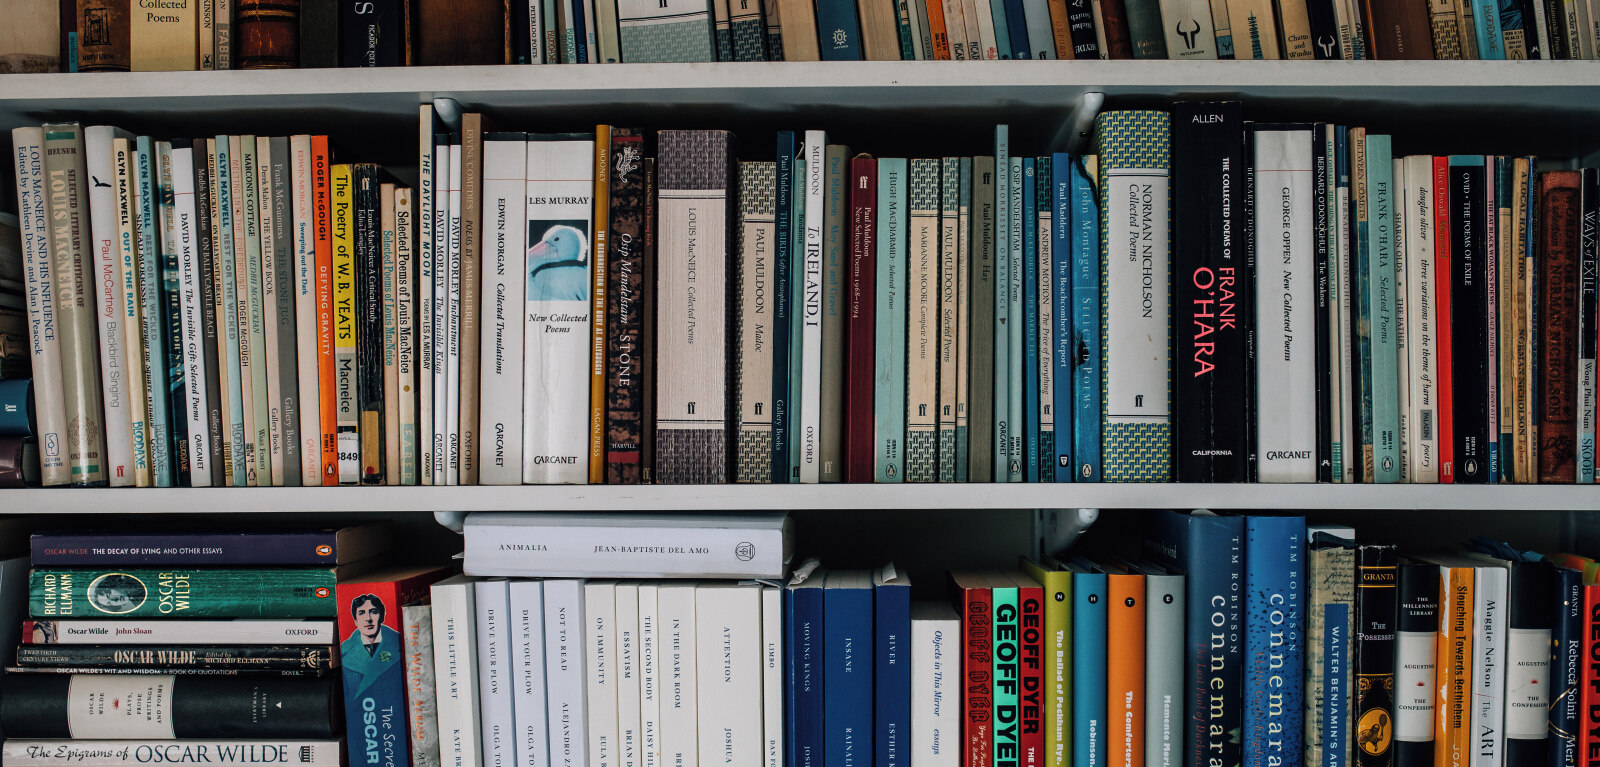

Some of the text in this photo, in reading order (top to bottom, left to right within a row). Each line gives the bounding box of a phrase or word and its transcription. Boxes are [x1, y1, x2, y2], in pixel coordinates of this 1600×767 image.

[147, 12, 180, 22] Poems
[1484, 5, 1498, 53] BLOODAXE
[218, 30, 229, 70] FABER
[1289, 49, 1312, 58] Windus
[1192, 114, 1223, 123] ALLEN
[18, 145, 29, 174] Edited
[29, 145, 42, 176] LOUIS
[317, 154, 325, 187] ROGER
[811, 145, 820, 195] MULDOON
[18, 176, 30, 188] by
[1059, 182, 1067, 199] Paul
[1378, 181, 1388, 220] FRANK
[21, 190, 33, 230] Kathleen
[1059, 201, 1067, 238] Maddern
[1128, 183, 1140, 261] Collected Poems
[1222, 156, 1231, 259] THE COLLECTED POEMS OF
[1282, 186, 1291, 264] GEORGE OPPEN
[24, 232, 35, 263] Devine
[36, 235, 48, 259] AND
[117, 150, 135, 316] GLYN MAXWELL OUT OF THE RAIN
[808, 226, 820, 238] To
[1142, 184, 1153, 318] NORMAN NICHOLSON
[27, 266, 37, 283] and
[39, 261, 49, 278] HIS
[334, 174, 352, 339] The Poetry of W. B. YEATS
[1059, 259, 1067, 275] The
[28, 286, 39, 306] Alan
[320, 265, 329, 308] DEFYING
[398, 210, 411, 373] Selected Poems of Louis MacNeice
[1219, 266, 1236, 330] FRANK
[40, 281, 54, 341] INFLUENCE
[100, 239, 120, 407] Paul McCartney Blackbird Singing
[550, 314, 587, 322] Collected
[617, 233, 633, 386] Osip Mandelstam STONE
[1193, 266, 1216, 376] O'HARA
[31, 319, 42, 354] Peacock
[321, 312, 330, 355] GRAVITY
[545, 325, 570, 333] Poems
[1057, 338, 1068, 367] Report
[340, 358, 353, 412] Macneice
[132, 420, 146, 469] BLOODAXE
[534, 456, 578, 464] CARCANET
[806, 425, 814, 463] OXFORD
[1266, 451, 1311, 460] CARCANET
[1581, 438, 1592, 475] SKOOB
[498, 544, 547, 552] ANIMALIA
[593, 545, 664, 554] JEAN-BAPTISTE
[668, 546, 685, 554] DEL
[45, 574, 56, 614] RICHARD
[60, 574, 72, 614] ELLMANN
[159, 572, 173, 614] OSCAR
[175, 574, 189, 610] WILDE
[1362, 573, 1393, 581] GRANTA
[673, 618, 680, 628] IN
[1229, 572, 1238, 652] ROBINSON
[113, 650, 195, 664] OSCAR WILDE
[723, 626, 731, 682] ATTENTION
[996, 603, 1016, 695] GEOFF
[1056, 630, 1064, 648] The
[1453, 585, 1467, 728] Slouching Towards Bethlehem
[1483, 599, 1496, 687] Maggie Nelson
[932, 630, 943, 716] Objects in This Mirror
[1023, 598, 1039, 734] GEOFF DYER
[1056, 650, 1064, 681] Ballad
[1566, 639, 1578, 719] Rebecca Solnit
[1056, 683, 1064, 694] of
[1330, 626, 1340, 748] WALTER BENJAMIN'S
[362, 697, 379, 763] OSCAR
[1056, 696, 1064, 741] Peckham
[26, 744, 287, 763] The Epigrams of OSCAR WILDE
[1481, 725, 1494, 758] ART
